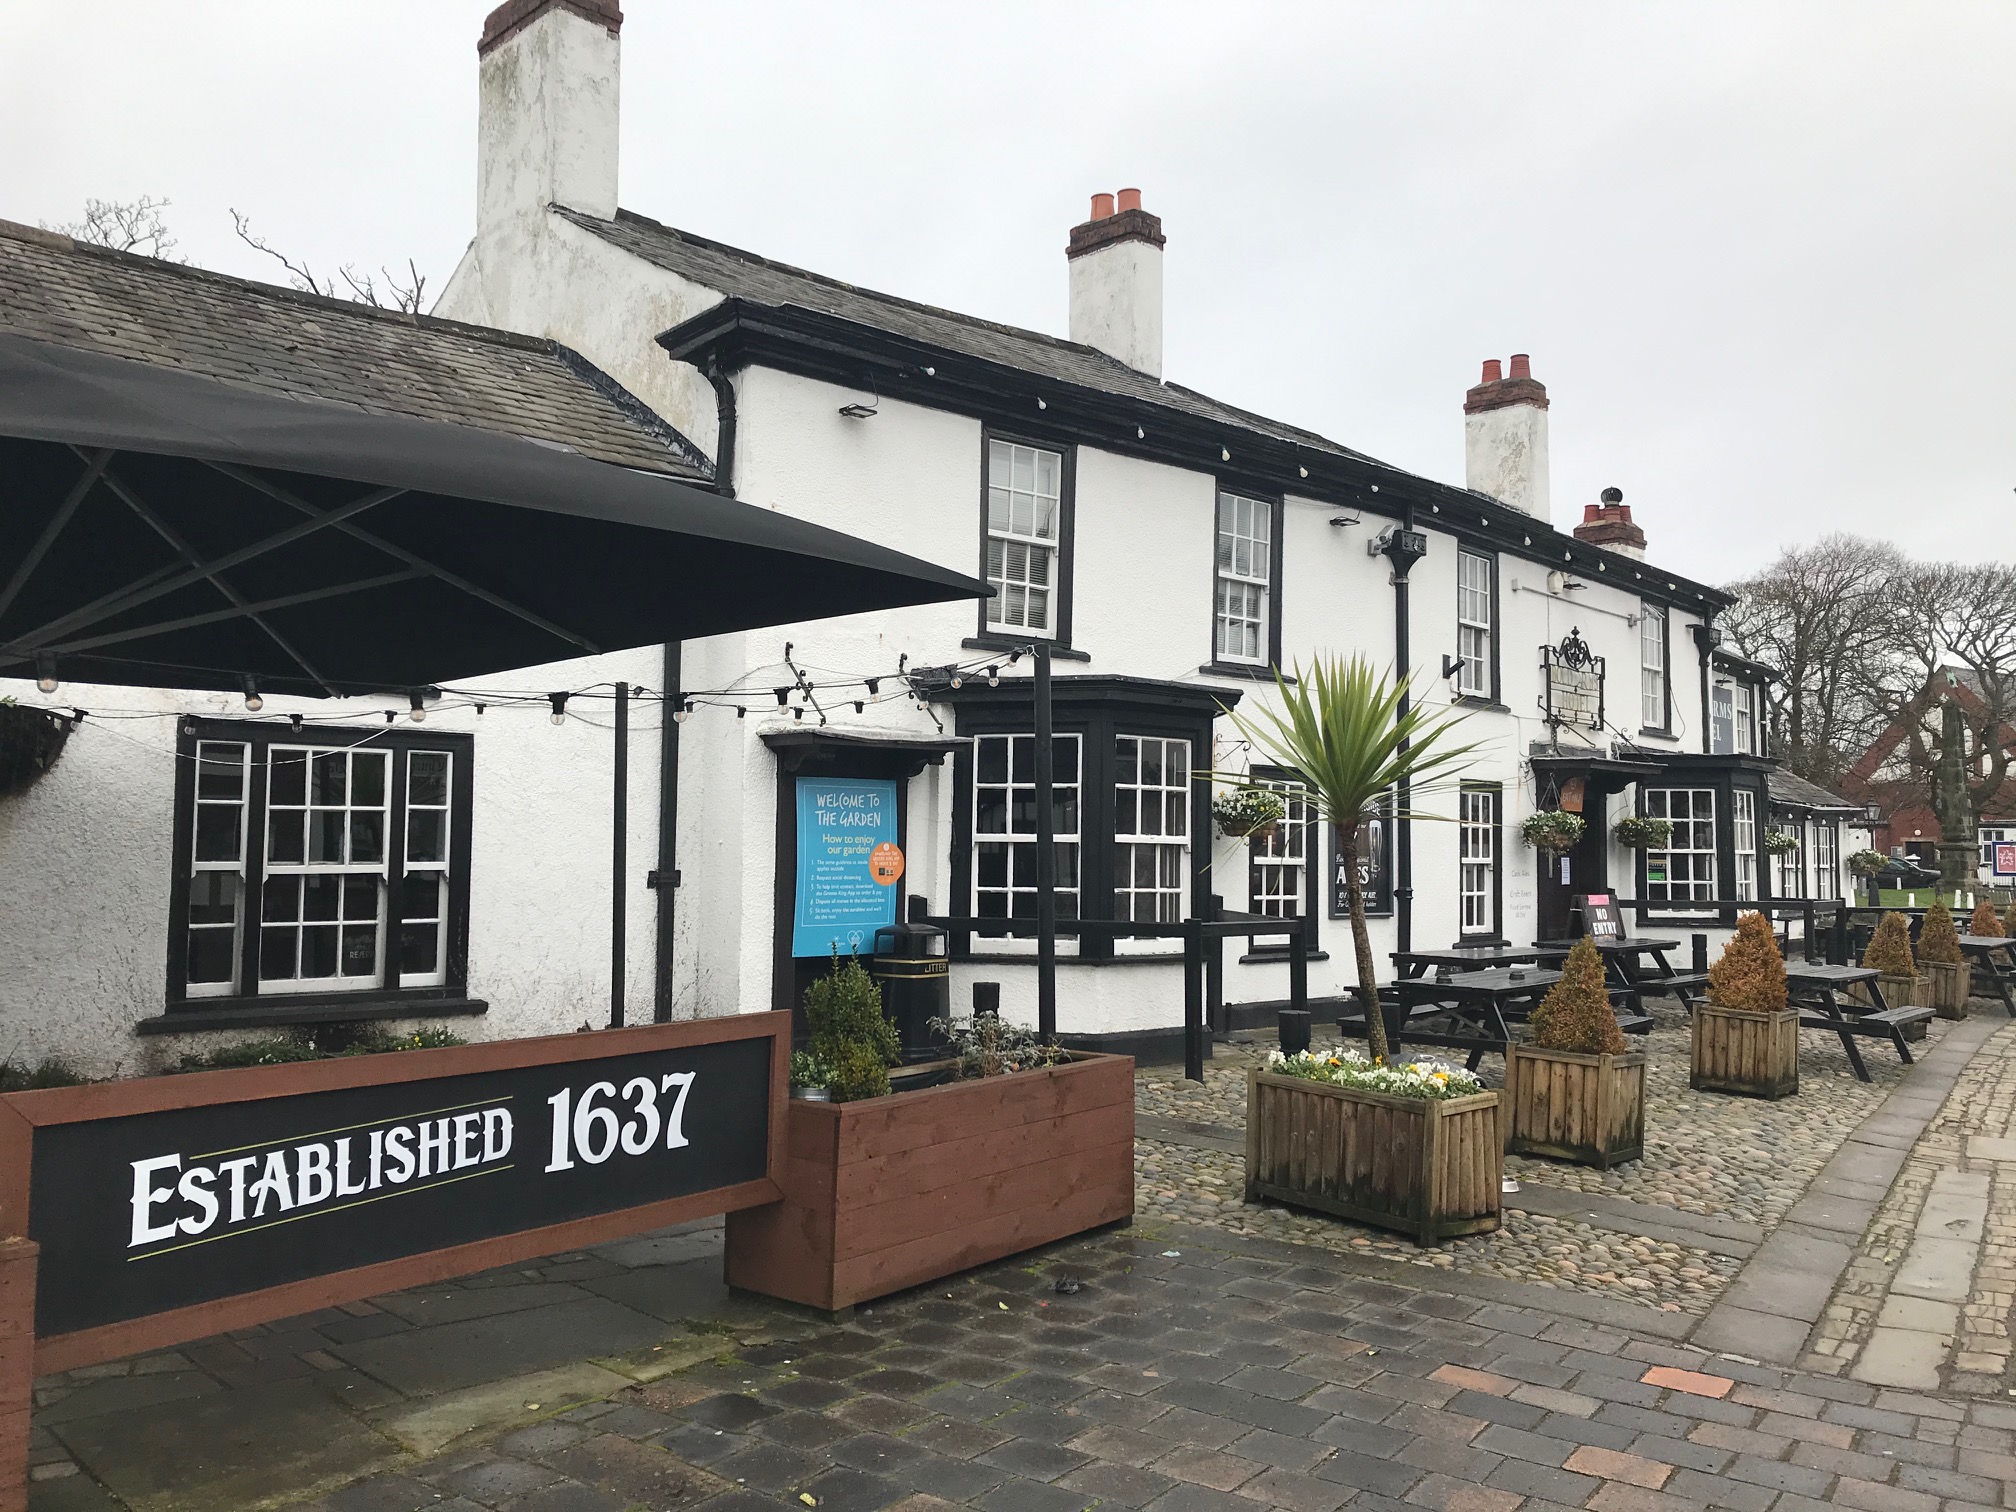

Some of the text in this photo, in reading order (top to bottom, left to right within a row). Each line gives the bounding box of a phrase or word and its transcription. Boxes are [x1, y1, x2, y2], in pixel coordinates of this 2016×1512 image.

[1712, 700, 1732, 720] RMS
[816, 792, 864, 810] WELCOME
[814, 810, 880, 828] THE GARDEN
[822, 834, 842, 844] How
[855, 835, 876, 846] enjoy
[843, 846, 870, 856] garden
[1336, 866, 1370, 884] AS
[1595, 908, 1608, 920] NO
[1592, 922, 1617, 935] ENTRY
[126, 1070, 697, 1248] ESTABLISHED 1637
